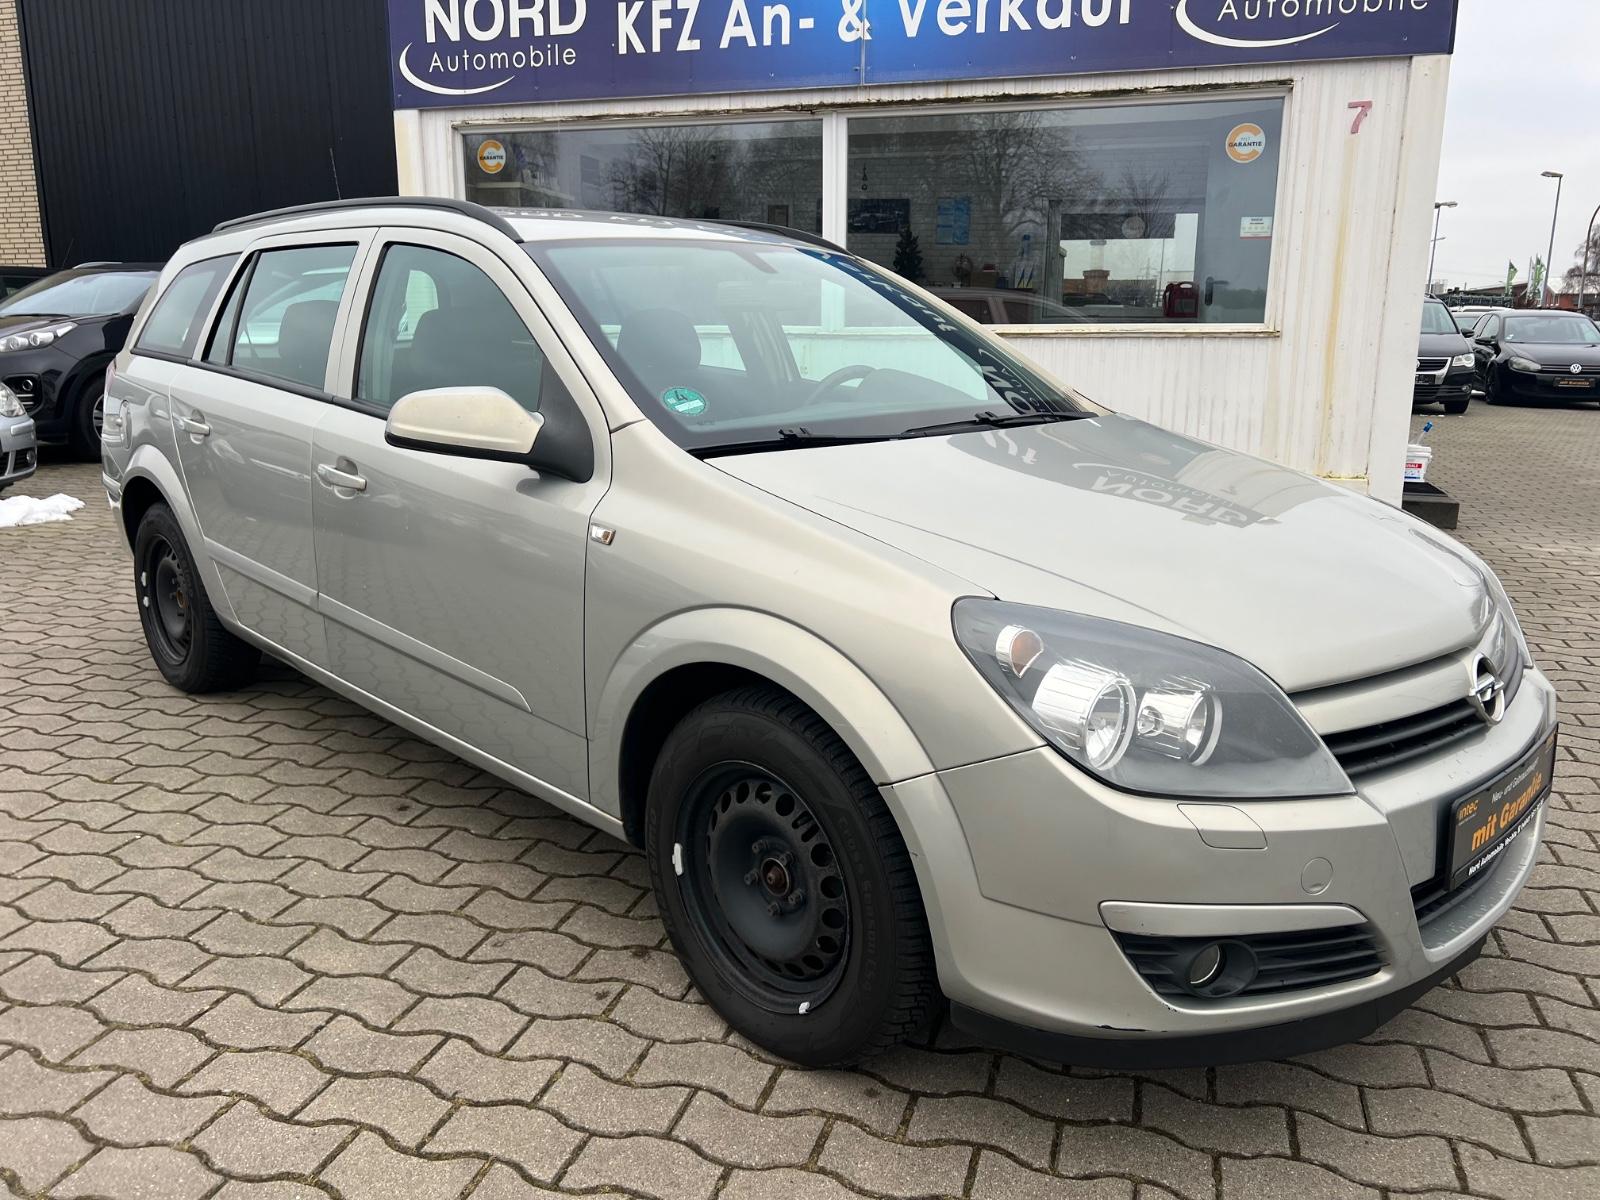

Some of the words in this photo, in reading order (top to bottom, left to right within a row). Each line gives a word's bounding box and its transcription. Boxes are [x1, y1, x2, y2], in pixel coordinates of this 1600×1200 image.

[424, 0, 587, 43] NORD
[617, 0, 701, 55] KFZ
[719, 0, 815, 49] An-
[837, 0, 873, 43] &
[428, 43, 577, 73] Automobile
[1348, 100, 1373, 135] 7
[1471, 813, 1497, 852] mit
[1499, 771, 1541, 828] Garantie
[1468, 860, 1481, 876] Nord
